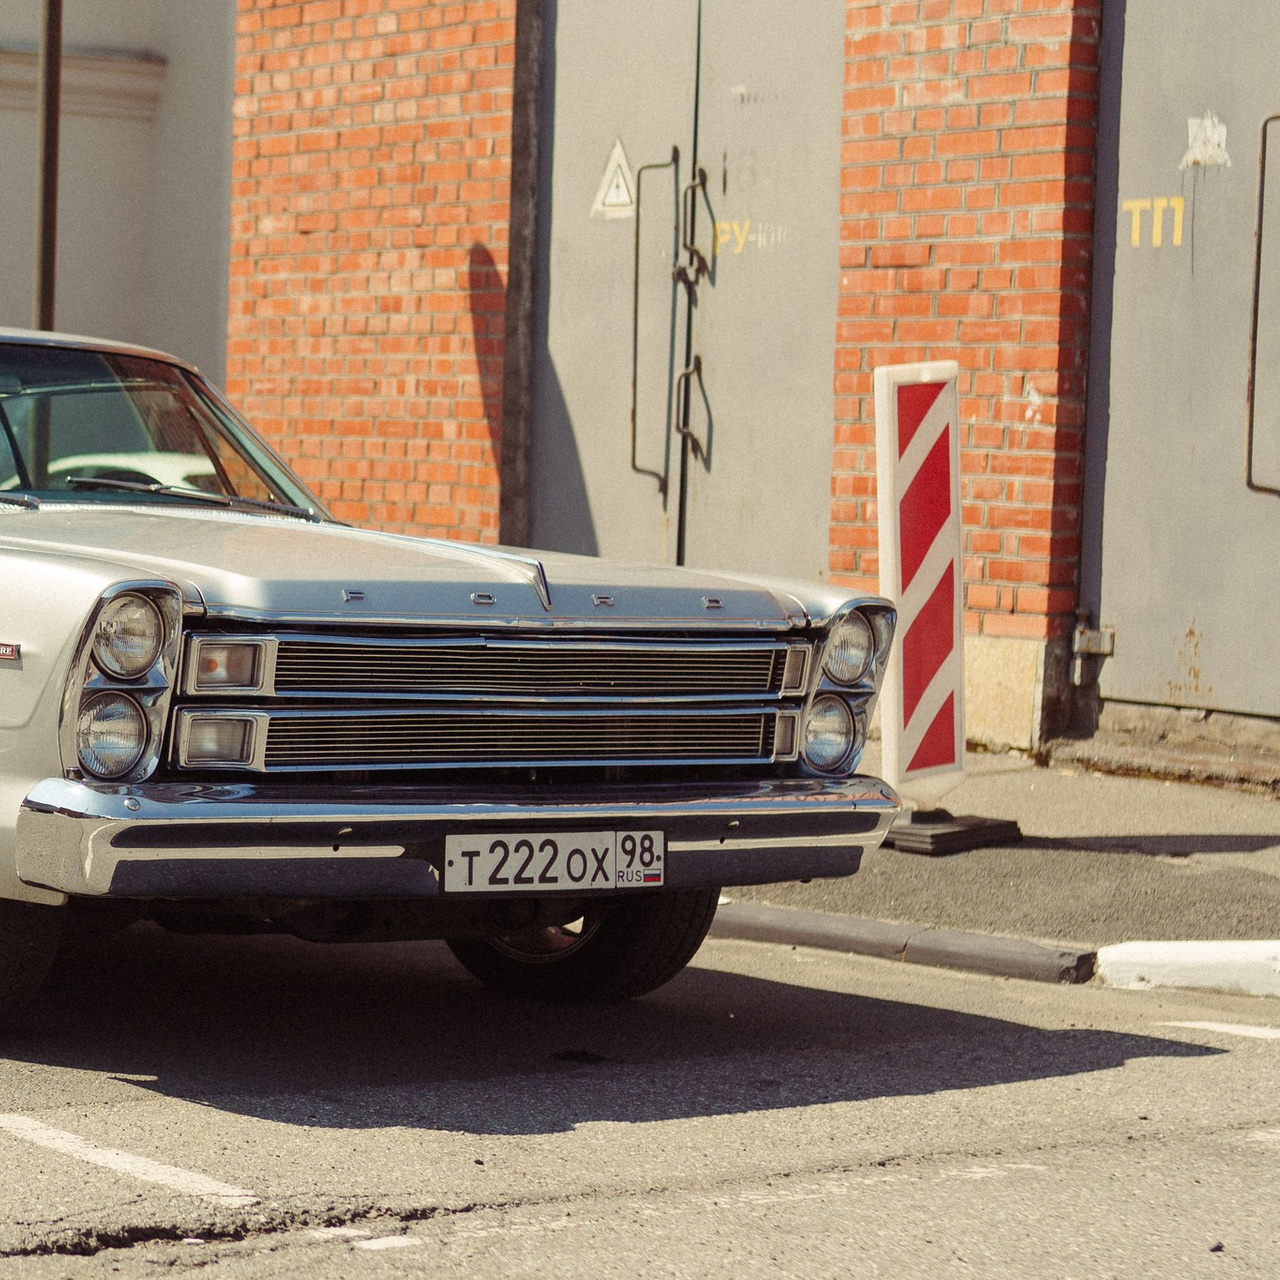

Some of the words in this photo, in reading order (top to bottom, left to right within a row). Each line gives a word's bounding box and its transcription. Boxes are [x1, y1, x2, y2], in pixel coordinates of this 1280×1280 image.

[1122, 196, 1185, 248] ТП
[341, 588, 724, 609] FORD
[621, 834, 655, 868] 98
[617, 870, 643, 883] RUS
